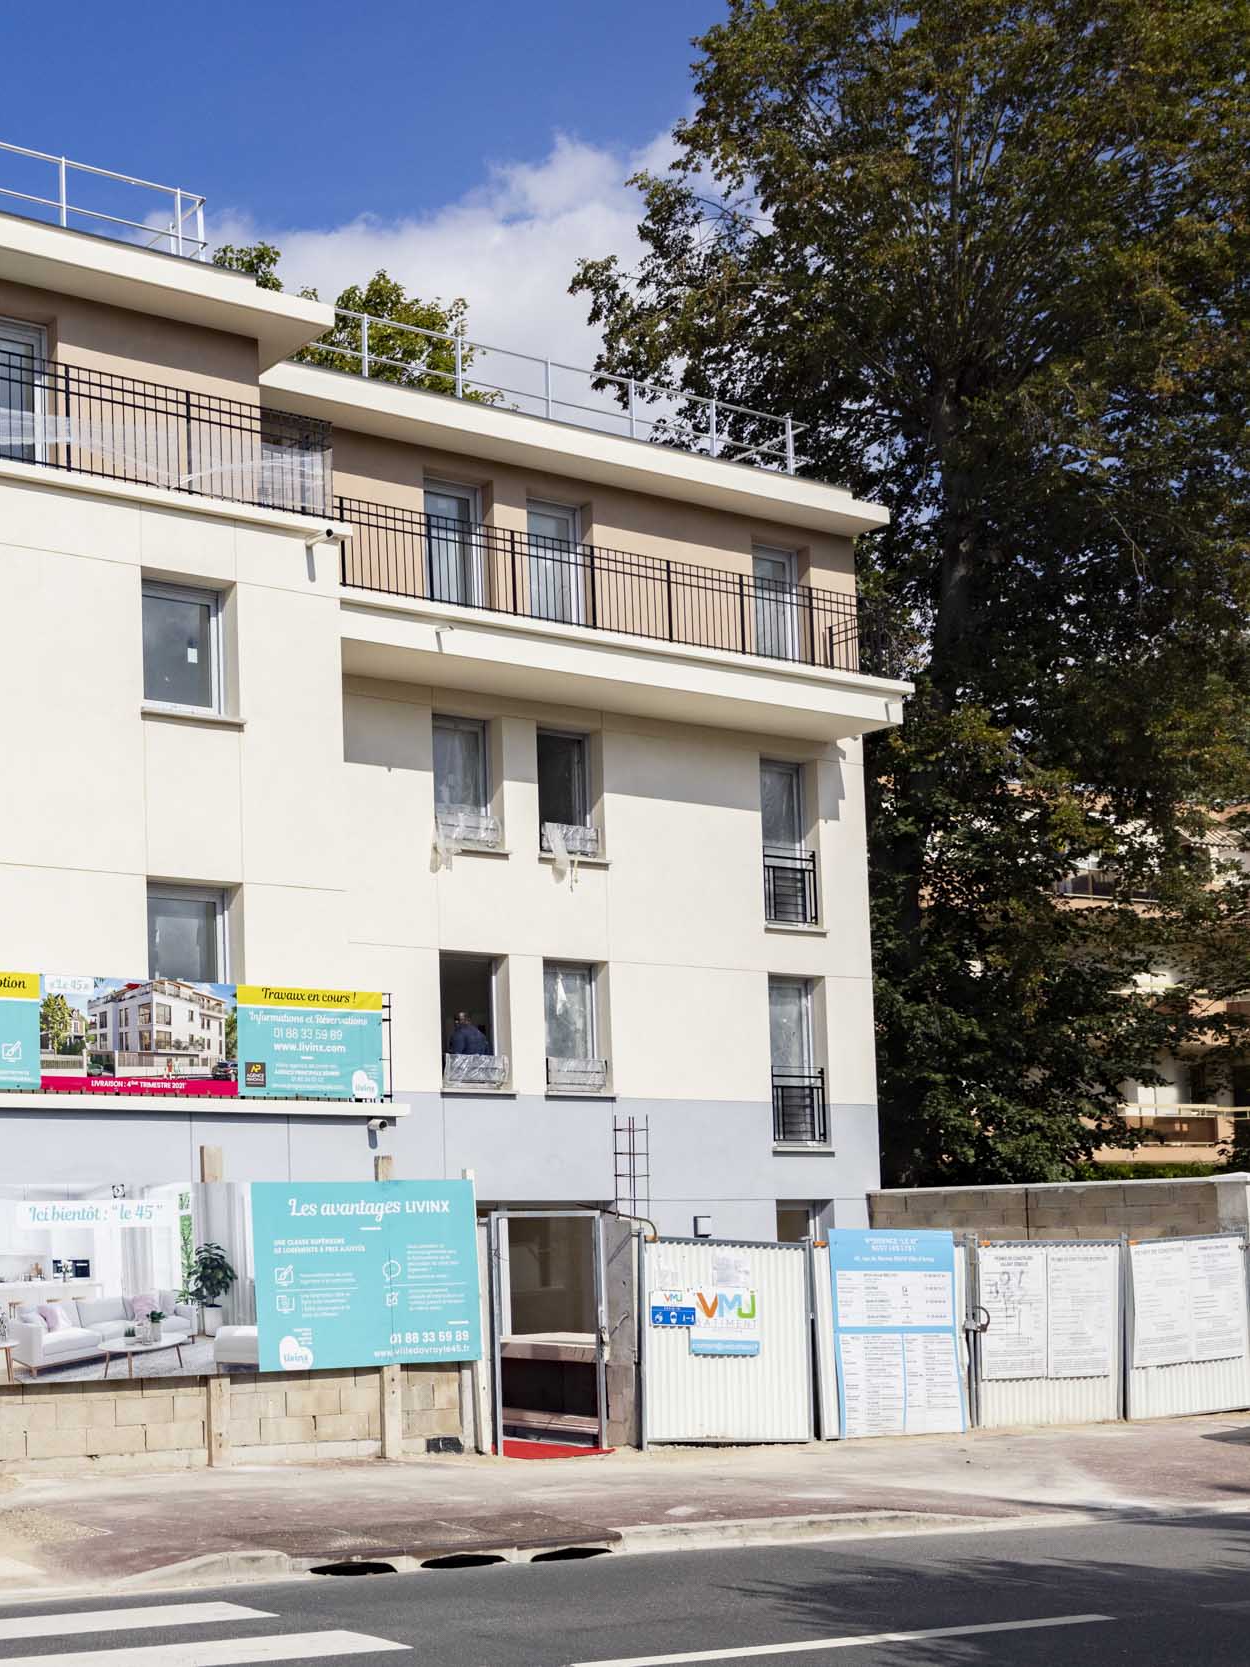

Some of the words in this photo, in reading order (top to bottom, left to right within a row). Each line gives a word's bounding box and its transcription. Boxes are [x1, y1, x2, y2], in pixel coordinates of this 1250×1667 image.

[262, 987, 306, 1001] Travaux
[308, 993, 320, 1002] en
[321, 994, 350, 1003] cours
[248, 1010, 304, 1025] Informations
[305, 1016, 314, 1024] et
[315, 1013, 368, 1026] Réservations
[273, 1027, 284, 1038] 01
[300, 1028, 313, 1039] 33
[29, 1204, 49, 1222] Ici
[51, 1205, 100, 1221] bientôt
[288, 1198, 318, 1217] Les
[320, 1200, 401, 1222] avantages
[405, 1199, 450, 1213] LIVINX
[696, 1291, 756, 1319] VMJ
[390, 1333, 402, 1345] 01
[422, 1331, 436, 1343] 33
